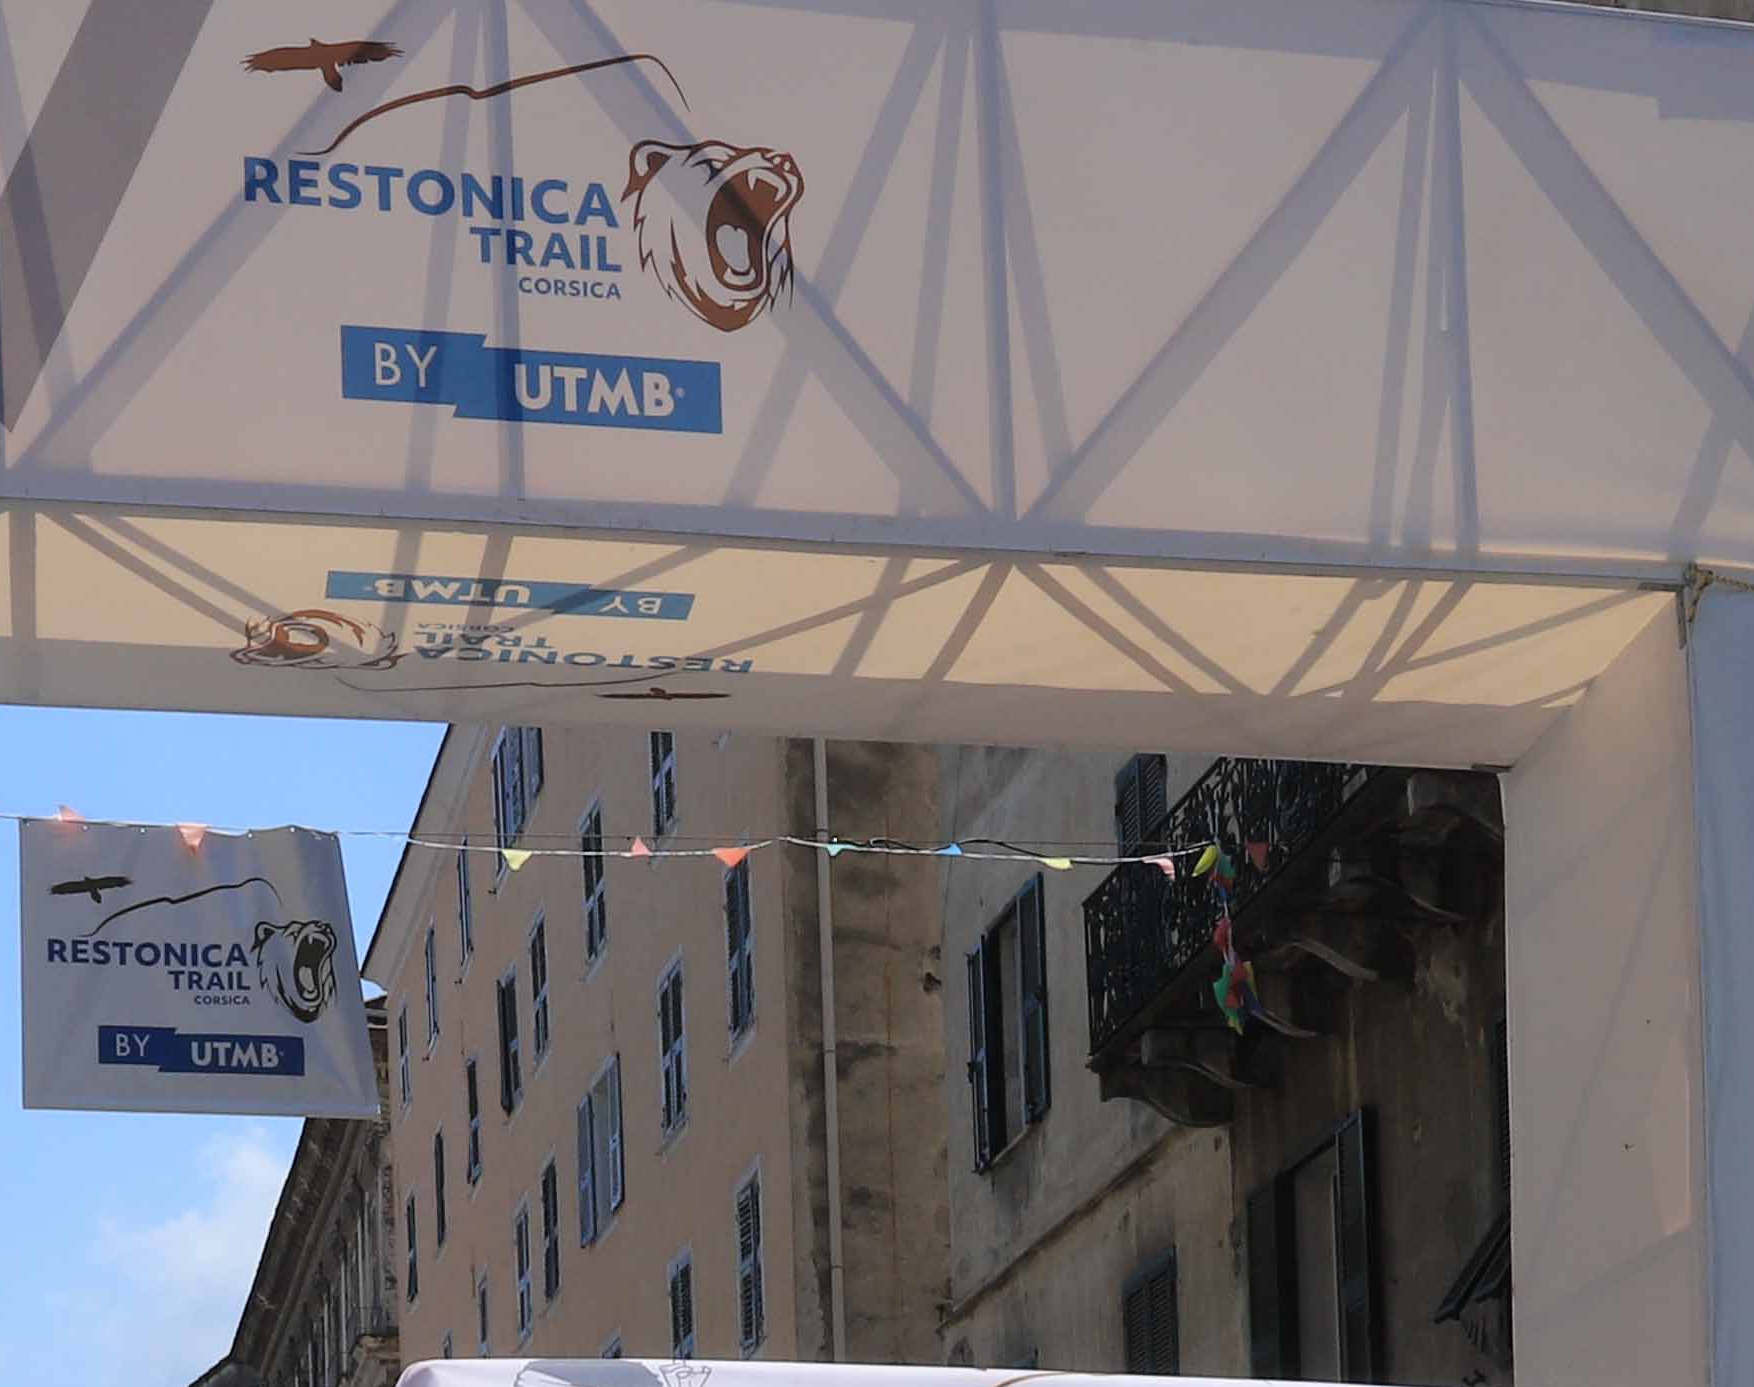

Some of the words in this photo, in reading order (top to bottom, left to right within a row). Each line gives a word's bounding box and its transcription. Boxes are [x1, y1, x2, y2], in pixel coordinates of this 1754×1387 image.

[244, 155, 620, 229] RESTONICA
[469, 226, 622, 273] TRAIL
[518, 276, 622, 300] CORSICA
[374, 341, 438, 388] BY
[513, 361, 677, 417] UTMB
[47, 938, 249, 968] RESTONICA
[169, 970, 251, 992] TRAIL
[194, 995, 251, 1006] CORSICA
[116, 1034, 150, 1057] BY
[191, 1041, 280, 1068] UTMB
